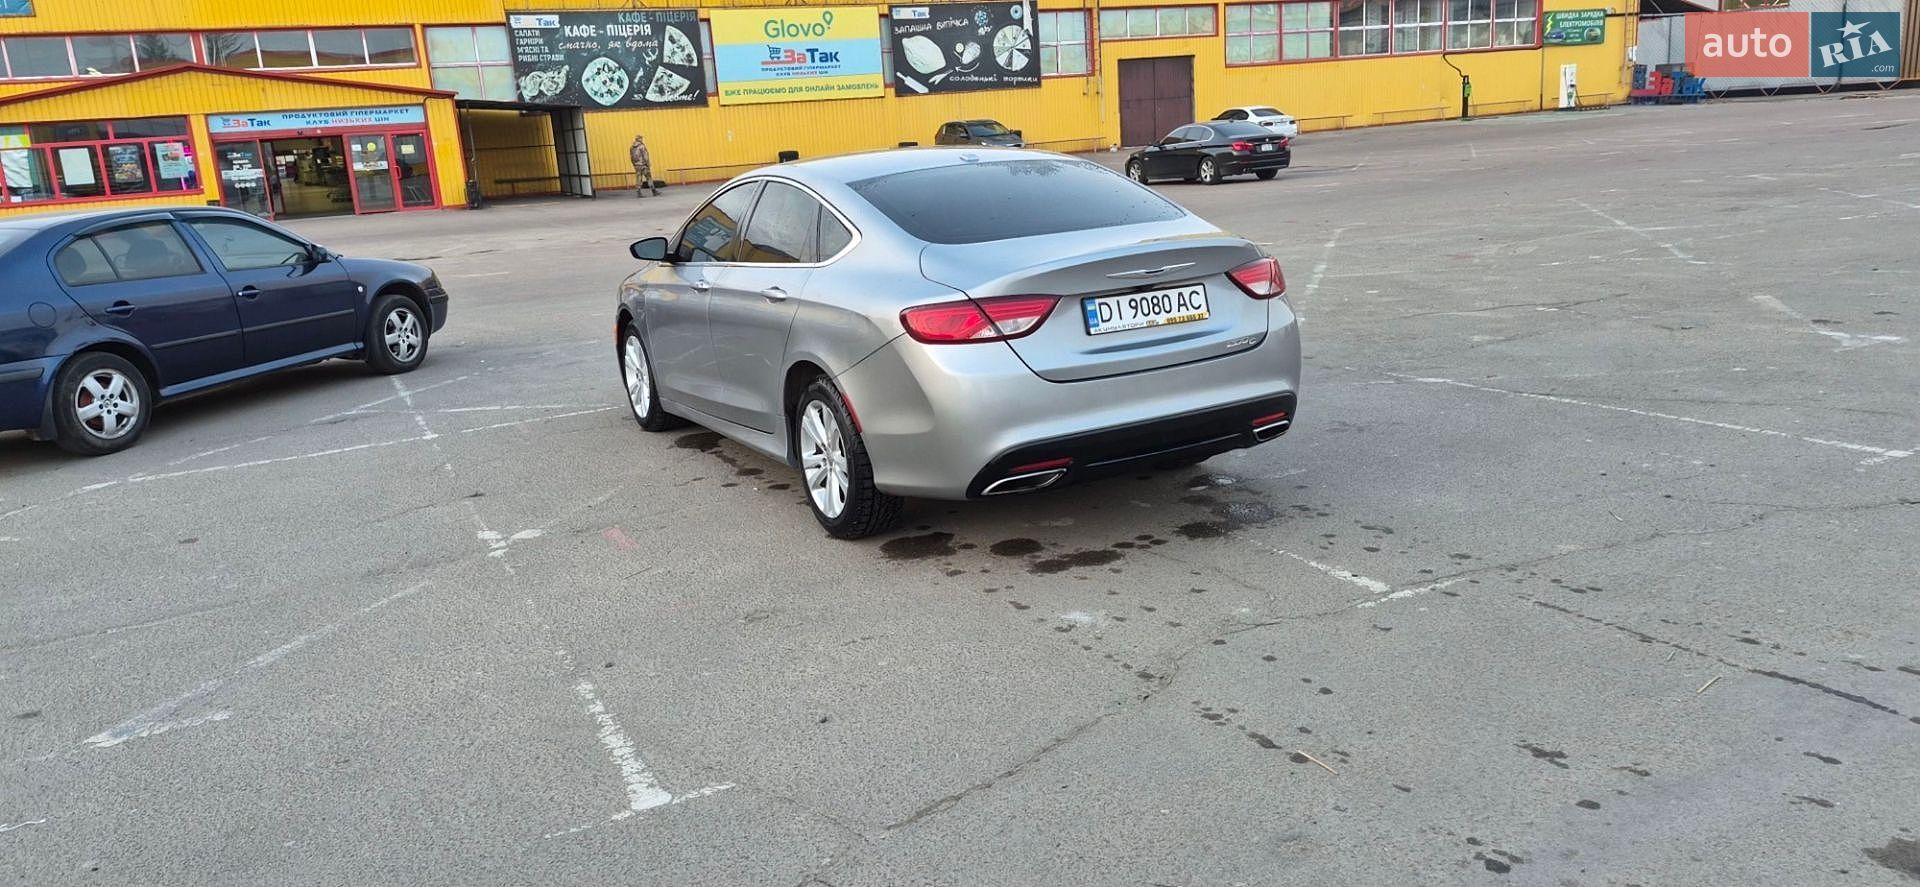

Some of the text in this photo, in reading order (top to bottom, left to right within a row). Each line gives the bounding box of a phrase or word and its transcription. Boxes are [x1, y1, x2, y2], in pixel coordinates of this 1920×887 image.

[618, 12, 647, 23] КАФЕ
[656, 11, 696, 23] ПІЦЕРІЯ
[563, 24, 597, 38] КАФЕ
[606, 24, 652, 37] ПІЦЕРІЯ
[764, 19, 826, 38] Glovo
[894, 17, 969, 34] ЗАПАШНА ВИПІЧКА
[608, 41, 620, 49] як
[625, 38, 658, 51] вдома
[788, 86, 803, 94] ДЛЯ
[805, 85, 835, 93] ОНЛАЙН
[281, 108, 409, 119] ПРОДУКТОВИЙ ГІПЕРМАРКЕТ
[1098, 290, 1202, 323] DI 9080 AC
